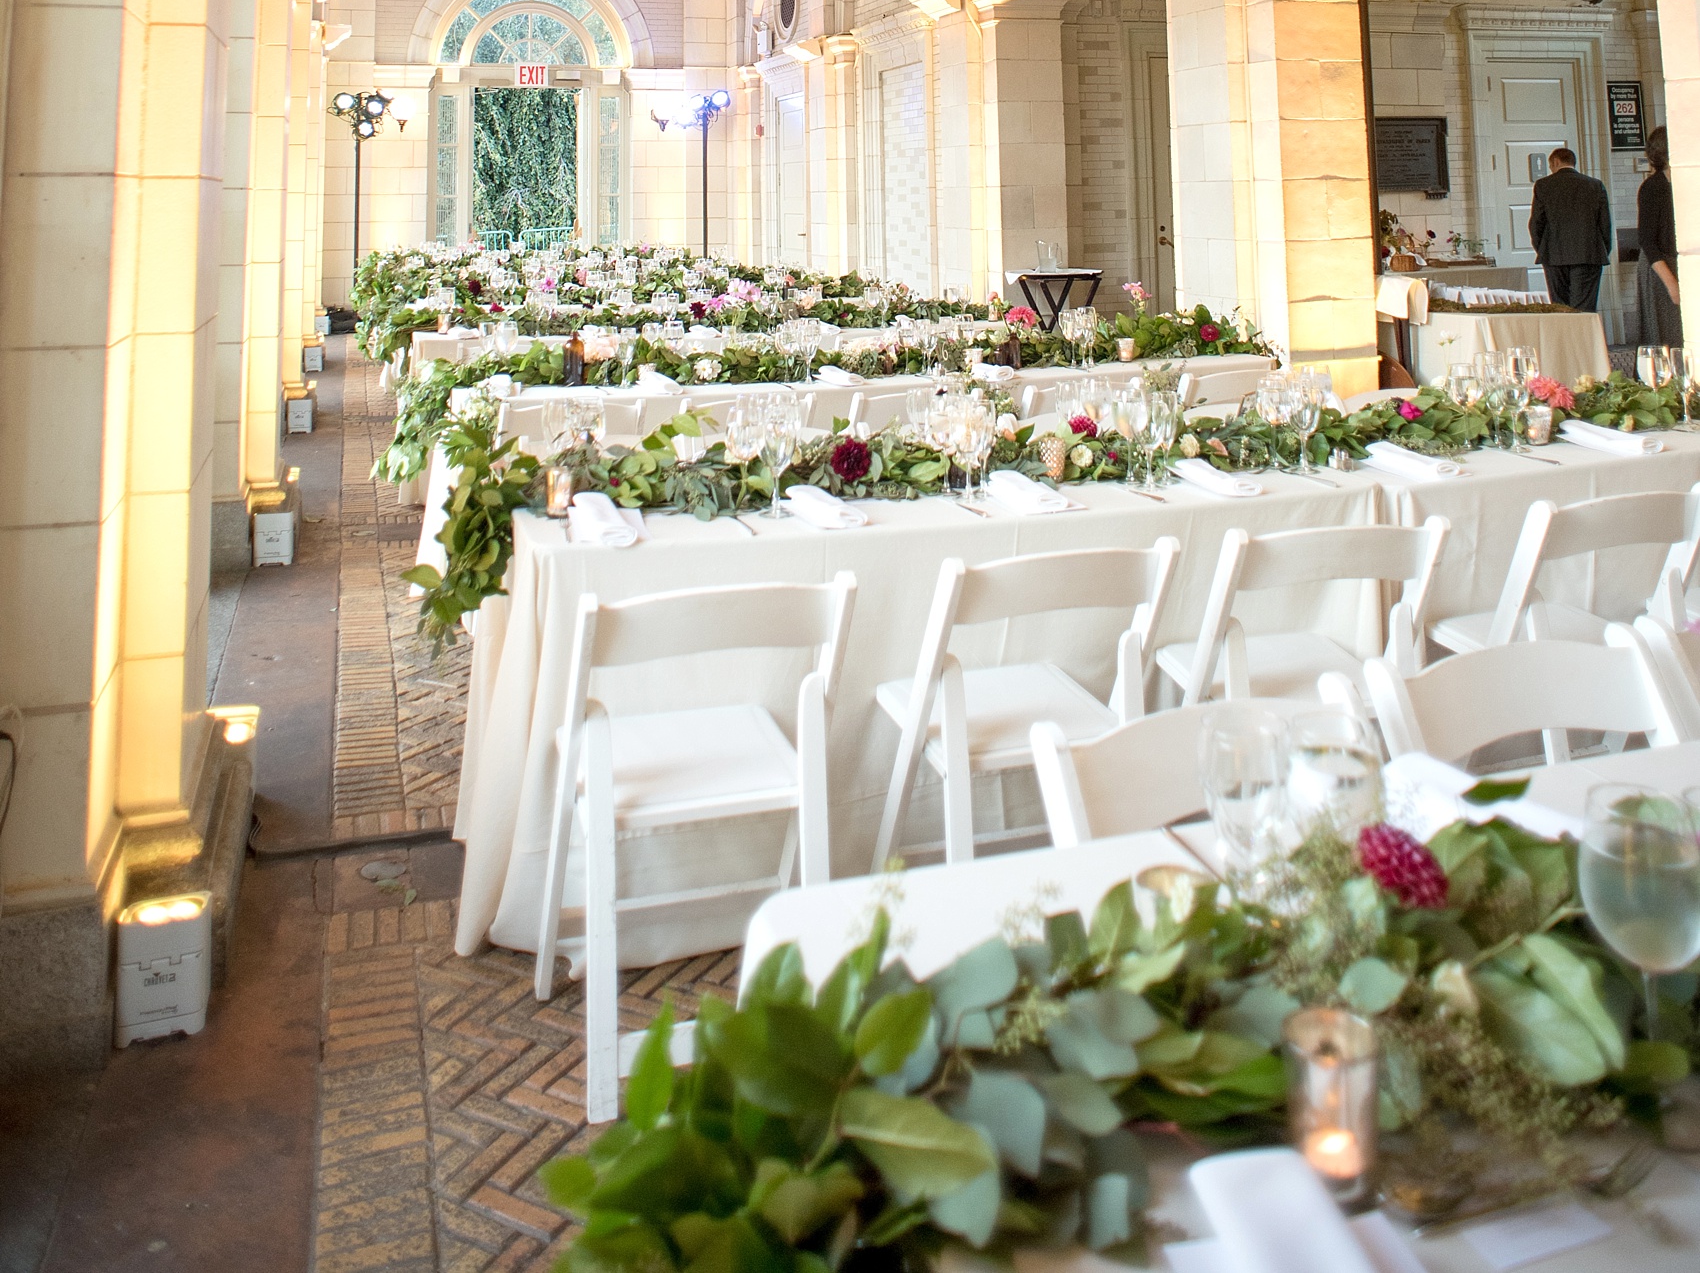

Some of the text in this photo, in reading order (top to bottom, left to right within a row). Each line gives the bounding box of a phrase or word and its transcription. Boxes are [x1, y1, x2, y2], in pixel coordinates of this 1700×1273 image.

[519, 66, 546, 85] EXIT
[1616, 103, 1633, 113] 262
[942, 342, 948, 361] 6
